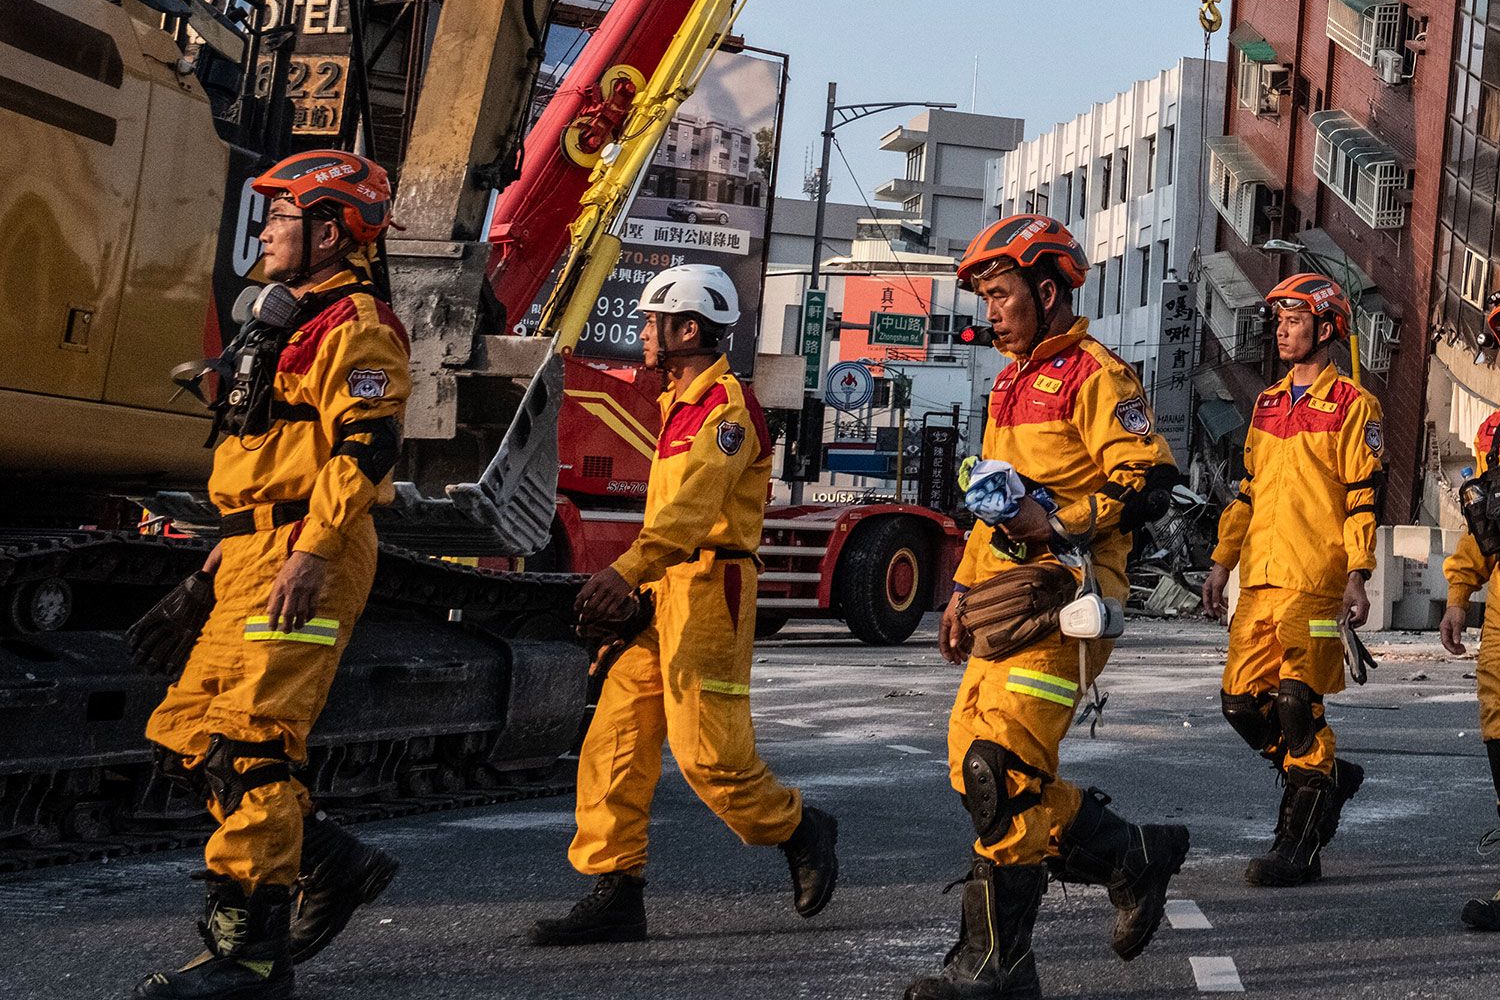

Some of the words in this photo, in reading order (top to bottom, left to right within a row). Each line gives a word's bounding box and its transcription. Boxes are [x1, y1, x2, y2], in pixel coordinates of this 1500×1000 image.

[654, 226, 740, 249] 面對公園綠地
[881, 316, 921, 332] 中山路
[879, 333, 909, 344] Zhongshan
[812, 492, 855, 503] LOUISA
